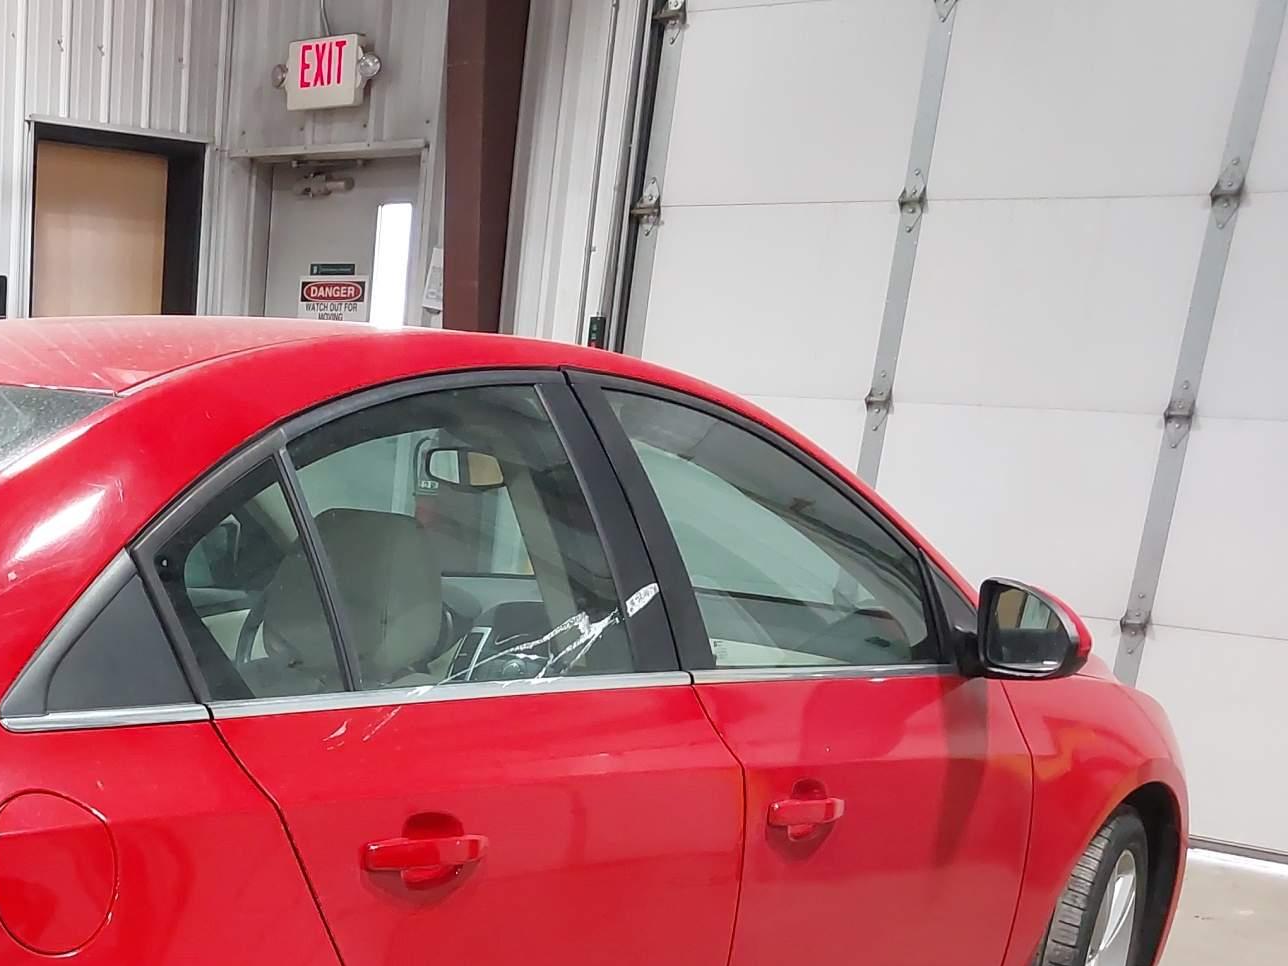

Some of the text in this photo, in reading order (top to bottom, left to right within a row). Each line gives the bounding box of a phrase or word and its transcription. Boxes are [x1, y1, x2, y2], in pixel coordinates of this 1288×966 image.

[300, 40, 347, 89] EXIT
[310, 286, 356, 298] DANGER
[305, 302, 358, 312] WATCH OUT FOR
[318, 312, 344, 321] MOVING
